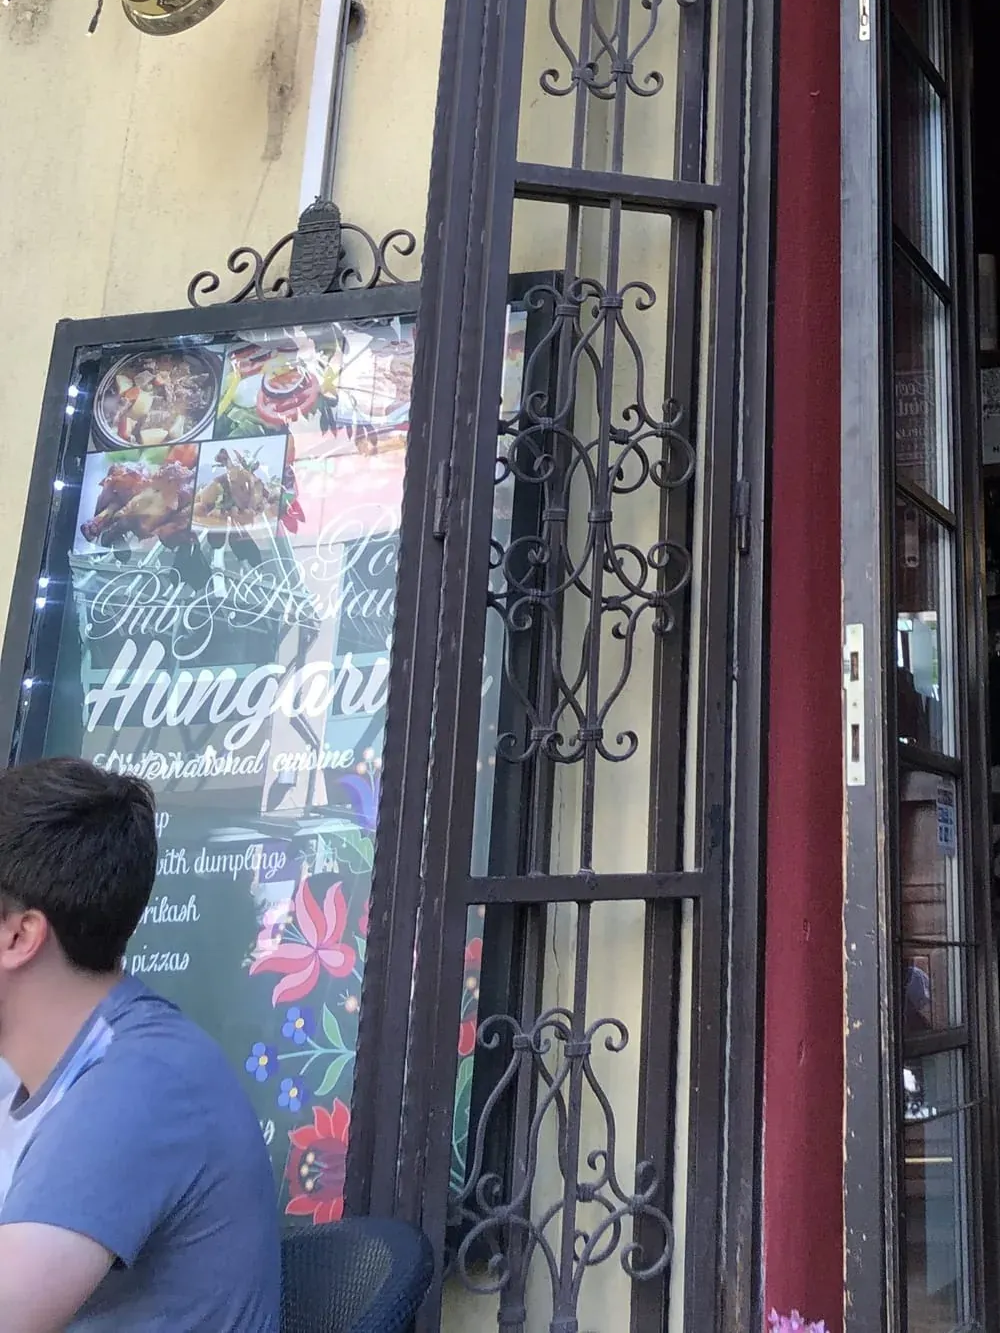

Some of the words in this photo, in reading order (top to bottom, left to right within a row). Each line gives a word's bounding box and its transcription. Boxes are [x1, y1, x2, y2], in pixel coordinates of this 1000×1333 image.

[86, 567, 181, 640] Pub
[272, 743, 356, 773] cuisine
[194, 847, 287, 881] dumplings
[132, 946, 190, 976] pizzas
